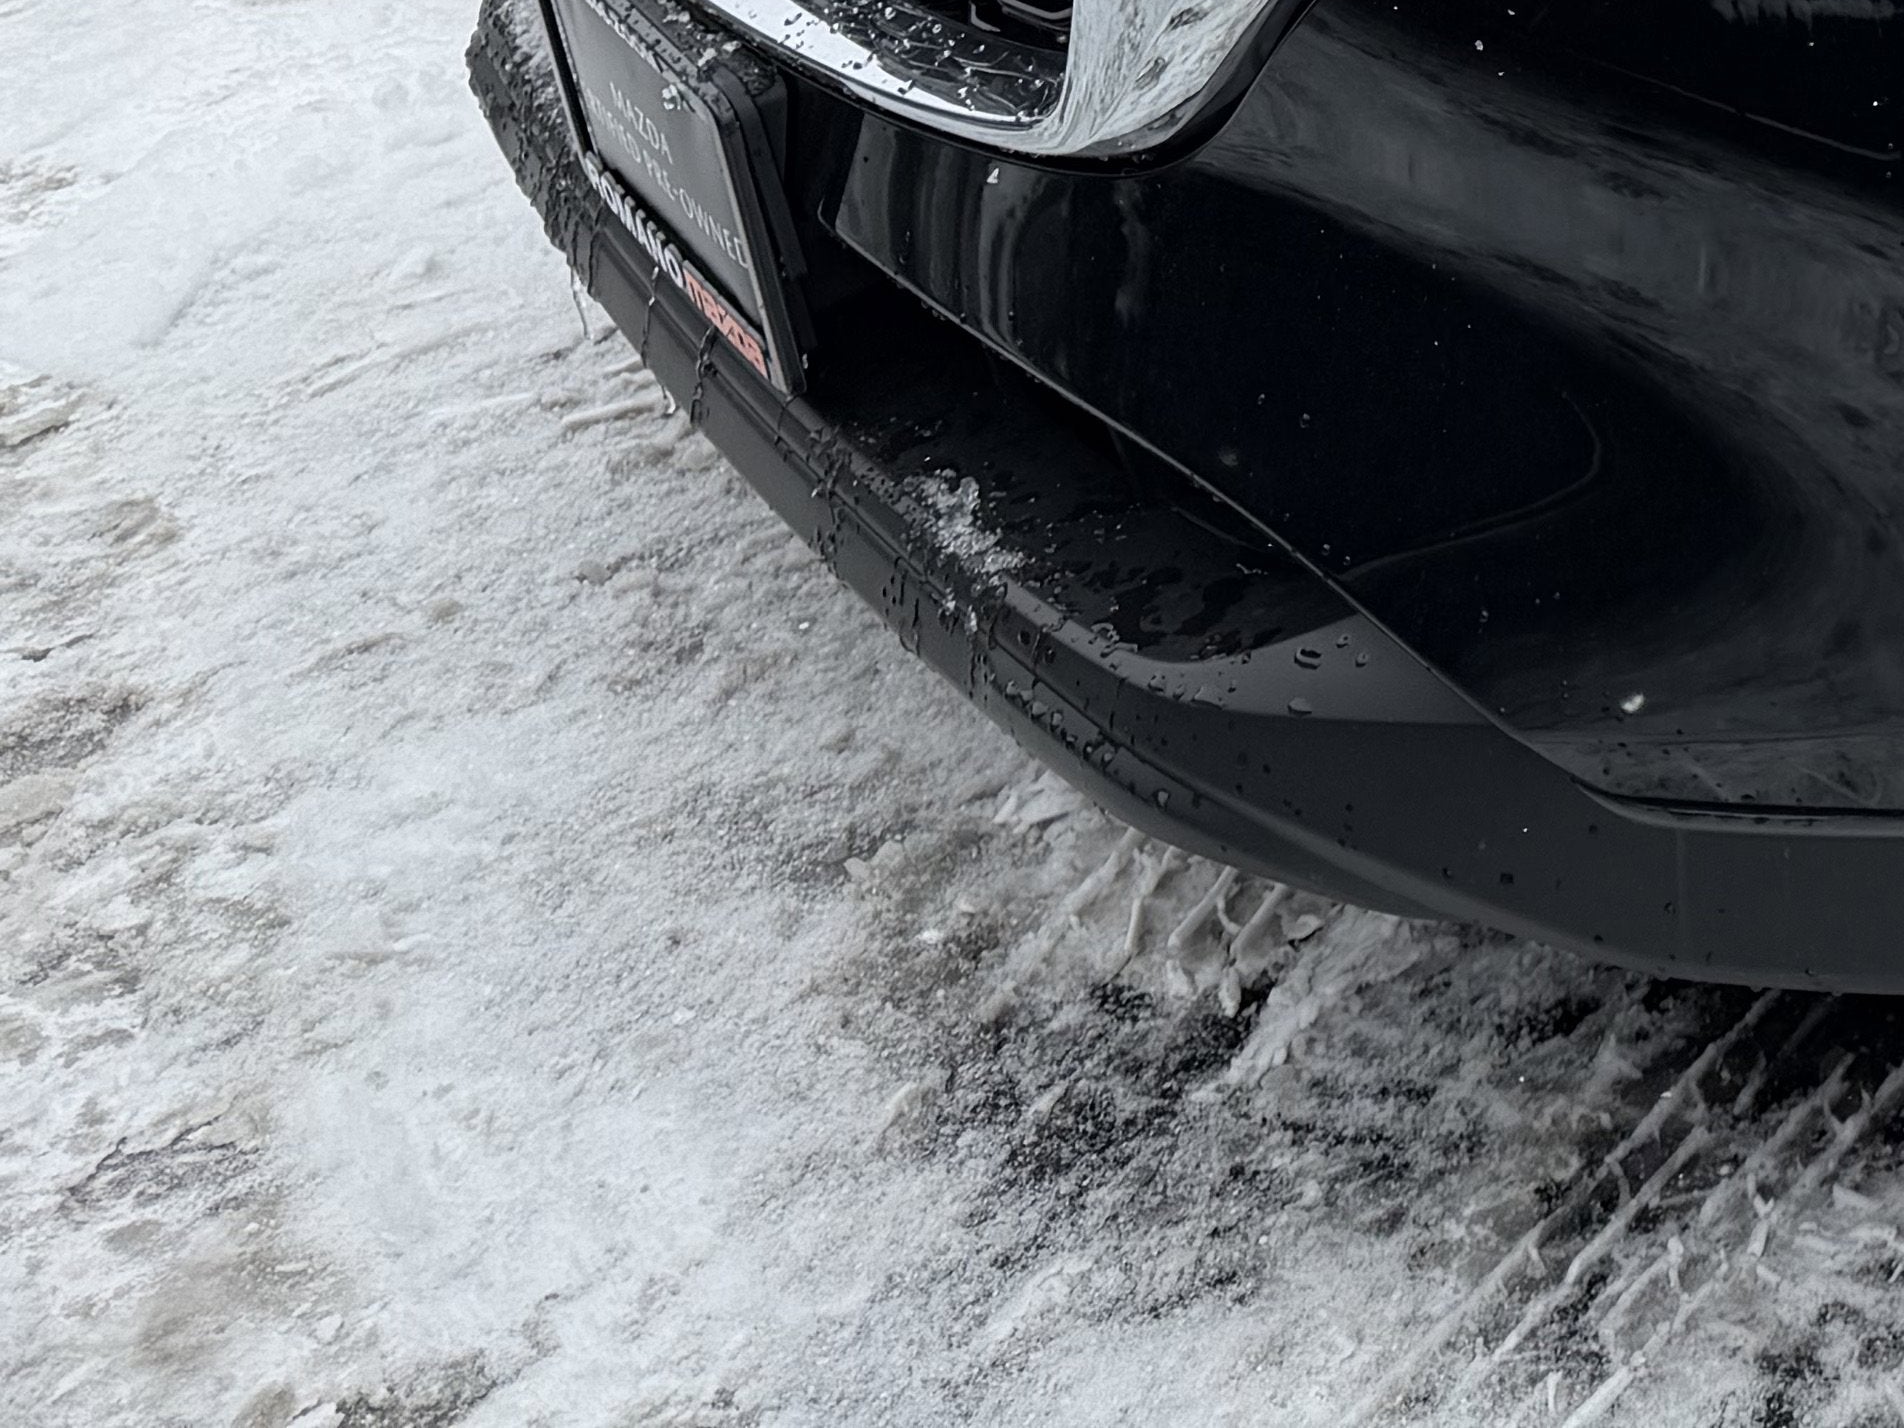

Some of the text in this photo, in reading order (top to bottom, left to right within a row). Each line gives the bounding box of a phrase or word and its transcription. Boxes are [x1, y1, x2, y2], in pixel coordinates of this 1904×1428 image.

[609, 81, 673, 165] MAZDA
[584, 152, 685, 291] ROMANO
[642, 148, 751, 269] PRE-OWNED
